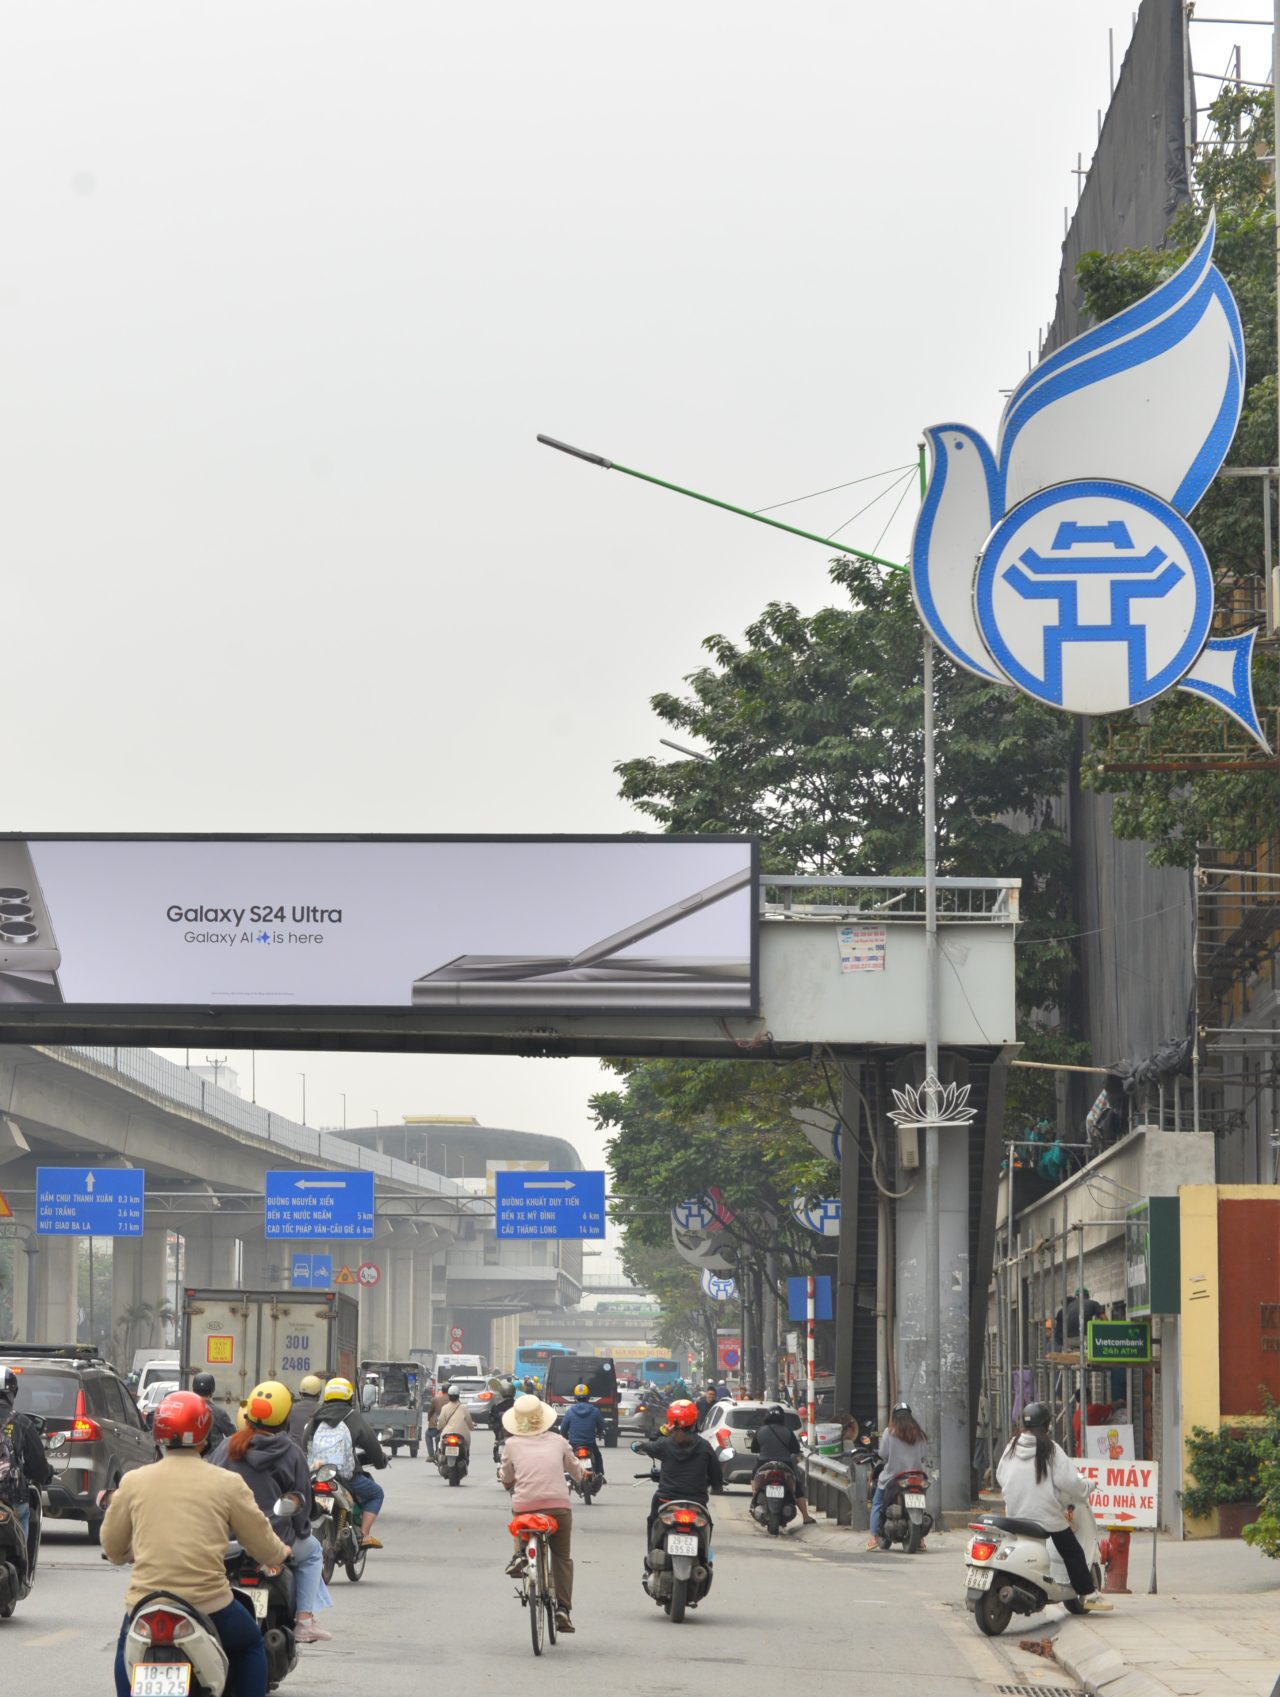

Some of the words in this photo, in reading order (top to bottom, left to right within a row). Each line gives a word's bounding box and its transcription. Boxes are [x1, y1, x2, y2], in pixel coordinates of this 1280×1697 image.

[167, 905, 245, 927] Galaxy
[250, 906, 286, 923] S24
[292, 905, 342, 923] Ultra
[184, 931, 236, 947] Galaxy
[240, 932, 253, 943] AI
[273, 931, 284, 943] is
[288, 932, 324, 944] here
[73, 1194, 94, 1203] THANH
[130, 1209, 140, 1217] km
[283, 1211, 291, 1220] XE
[363, 1212, 373, 1220] km
[517, 1212, 526, 1220] XE
[589, 1212, 600, 1220] km
[55, 1222, 70, 1230] GIAO
[130, 1223, 140, 1231] km
[267, 1225, 280, 1233] CAO
[363, 1226, 373, 1234] km
[539, 1225, 557, 1234] LONG
[589, 1226, 600, 1234] km
[1095, 1338, 1144, 1346] Vietcombank
[282, 1357, 310, 1371] 2486
[1106, 1465, 1152, 1488] MÁY
[1089, 1491, 1110, 1507] VÀO
[1113, 1492, 1136, 1509] NHÀ
[1140, 1496, 1154, 1509] XE
[144, 1666, 181, 1680] 18-C1
[135, 1681, 186, 1696] 383.25
